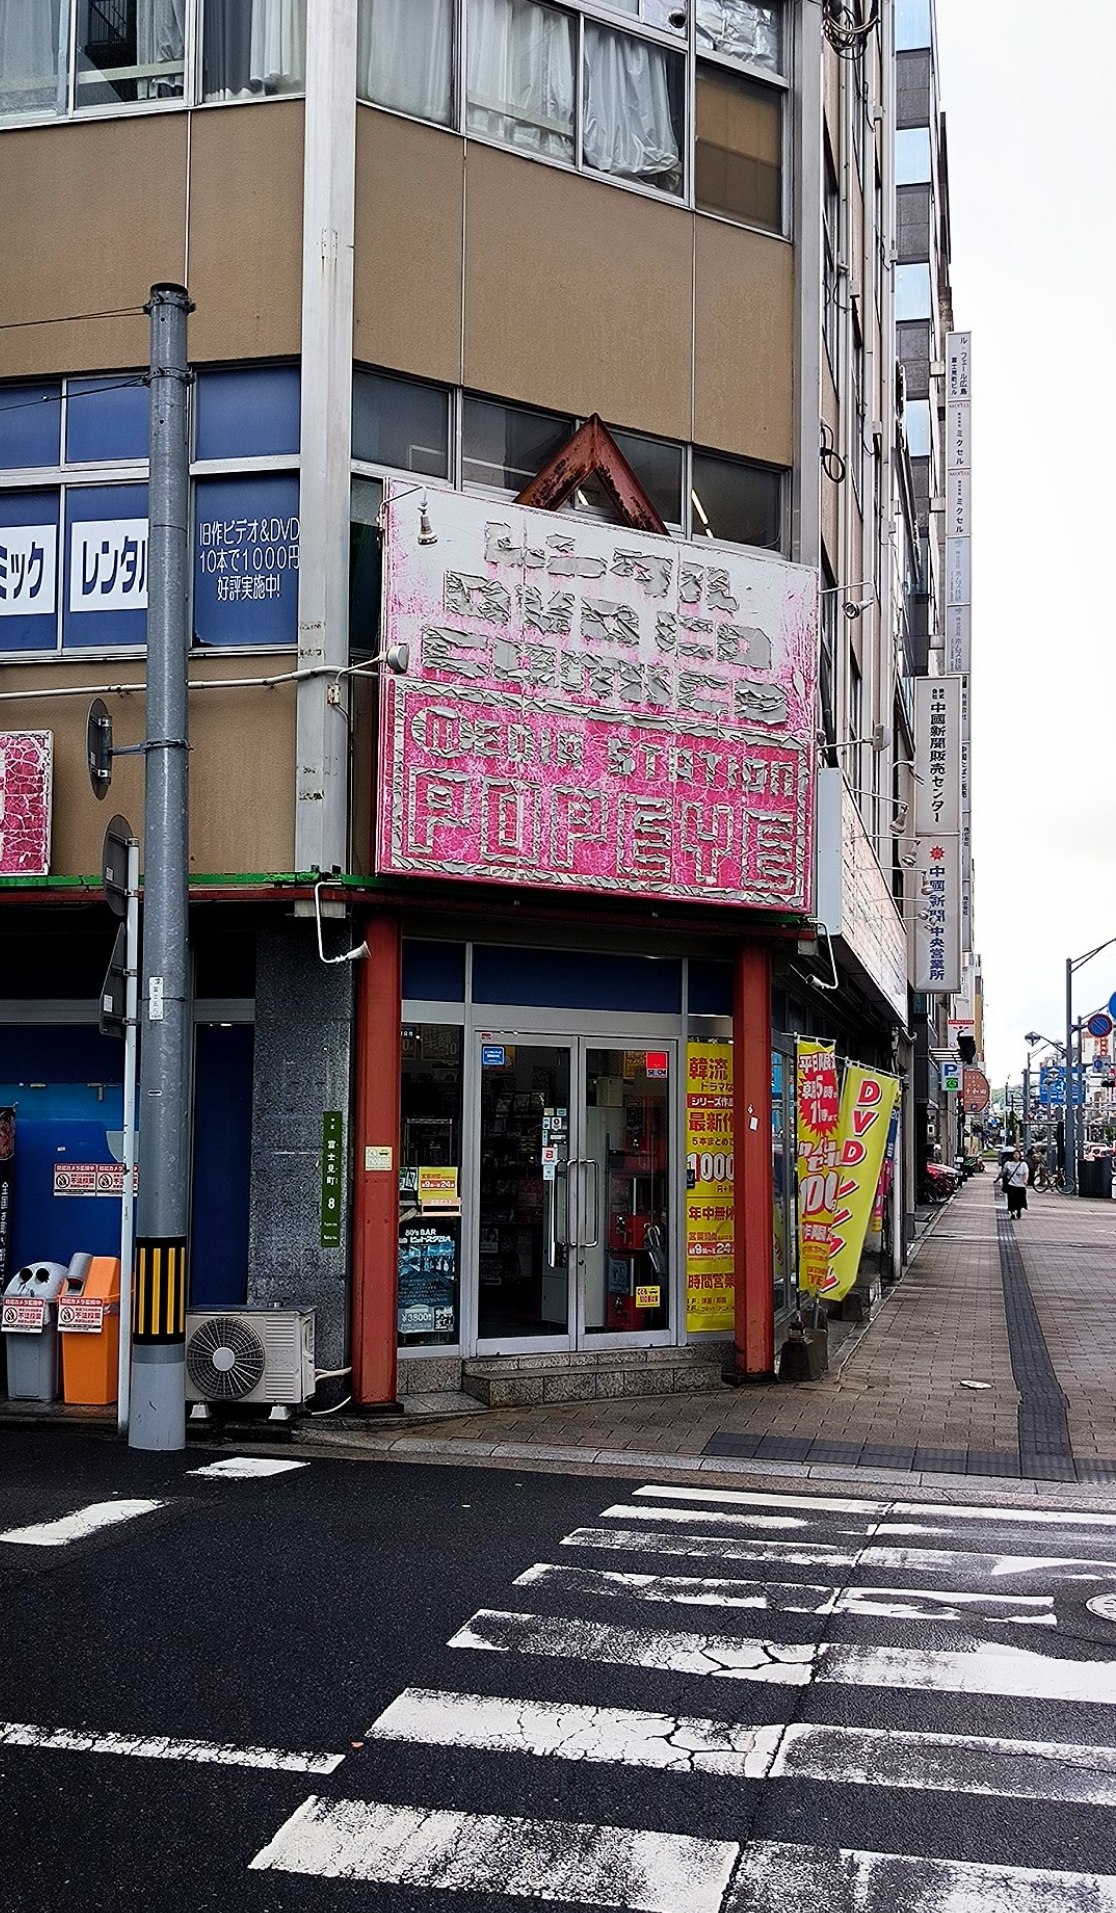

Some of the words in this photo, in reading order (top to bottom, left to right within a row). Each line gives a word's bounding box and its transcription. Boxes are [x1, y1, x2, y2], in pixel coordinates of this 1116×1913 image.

[199, 517, 300, 547] 旧作ビデオ&DVD
[199, 544, 300, 574] 10本で1000円
[217, 574, 281, 601] 好評実施中!
[410, 705, 584, 769] MEDIA
[607, 737, 795, 797] STATION
[929, 702, 946, 823] 中國新聞販売センター
[407, 764, 795, 890] POPEYE
[689, 1056, 729, 1081] 韓流
[944, 1063, 958, 1077] P
[326, 1139, 337, 1187] 富士見町
[327, 1196, 336, 1210] 8
[420, 1228, 437, 1236] BAR
